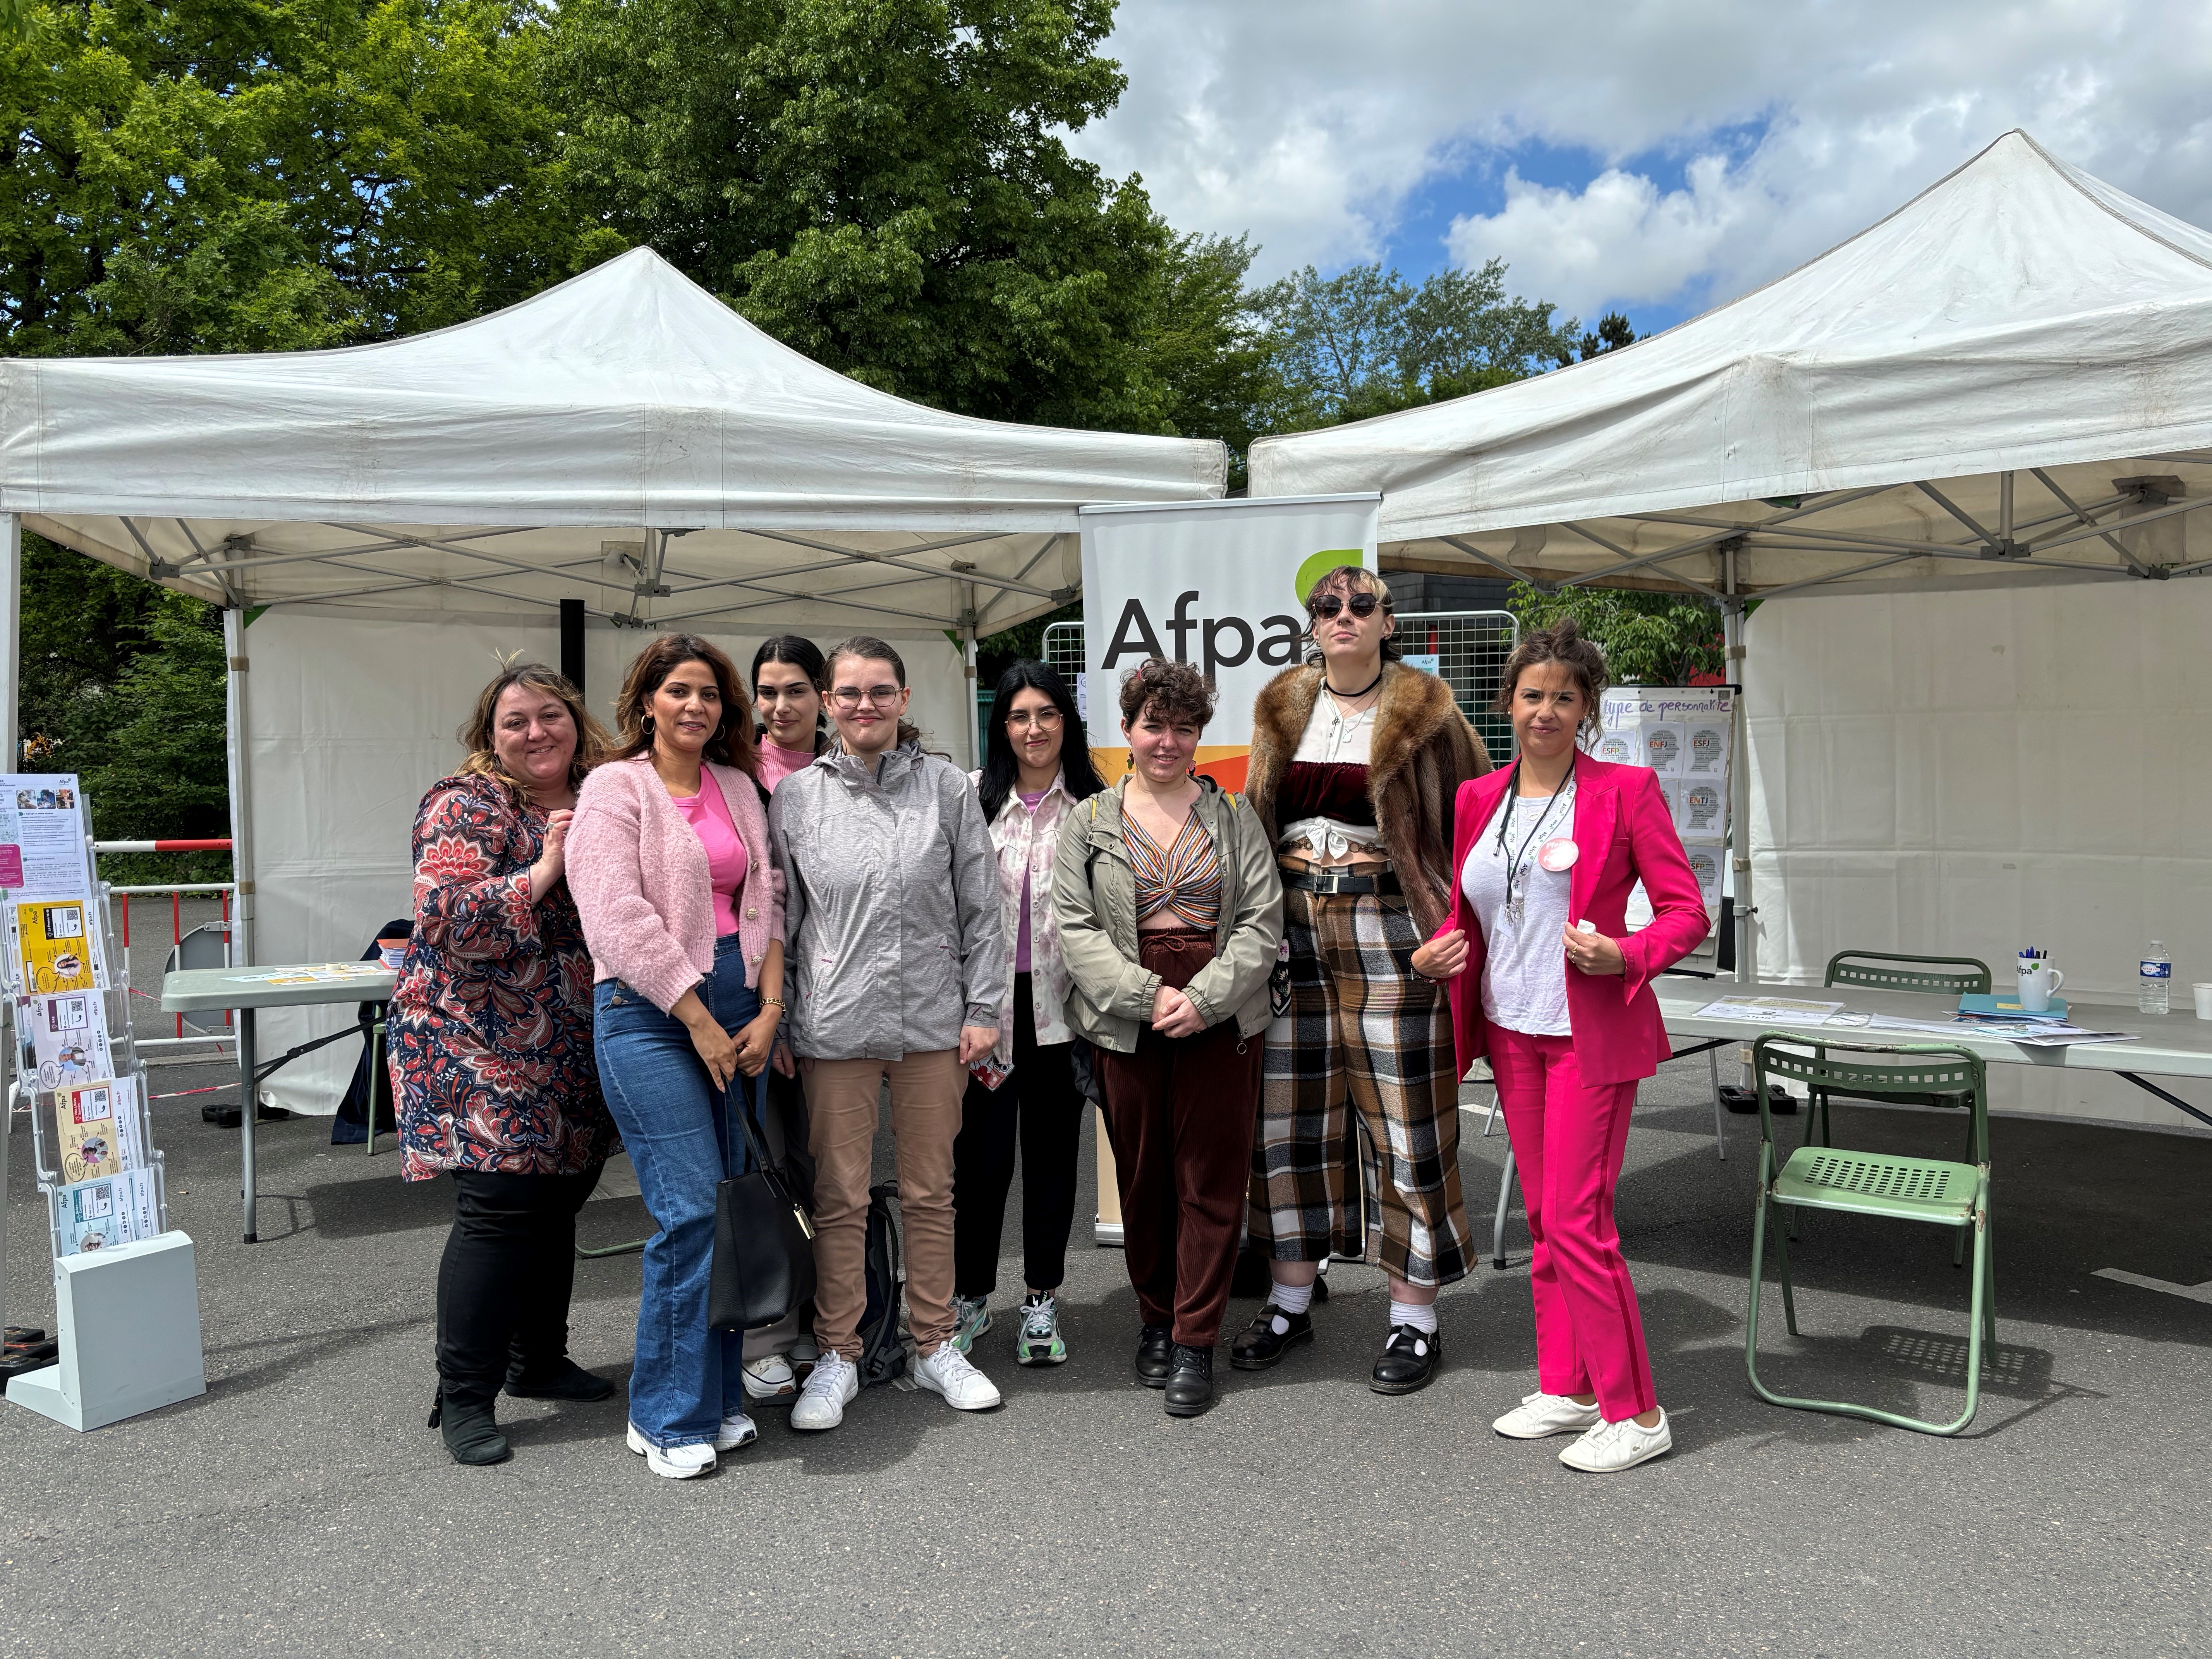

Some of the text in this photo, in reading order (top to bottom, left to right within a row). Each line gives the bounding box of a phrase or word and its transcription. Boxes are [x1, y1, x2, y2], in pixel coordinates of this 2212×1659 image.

[1101, 590, 1302, 689] Afpa
[1604, 699, 1633, 730] type
[1639, 700, 1655, 712] de
[1520, 863, 1528, 874] Afpa
